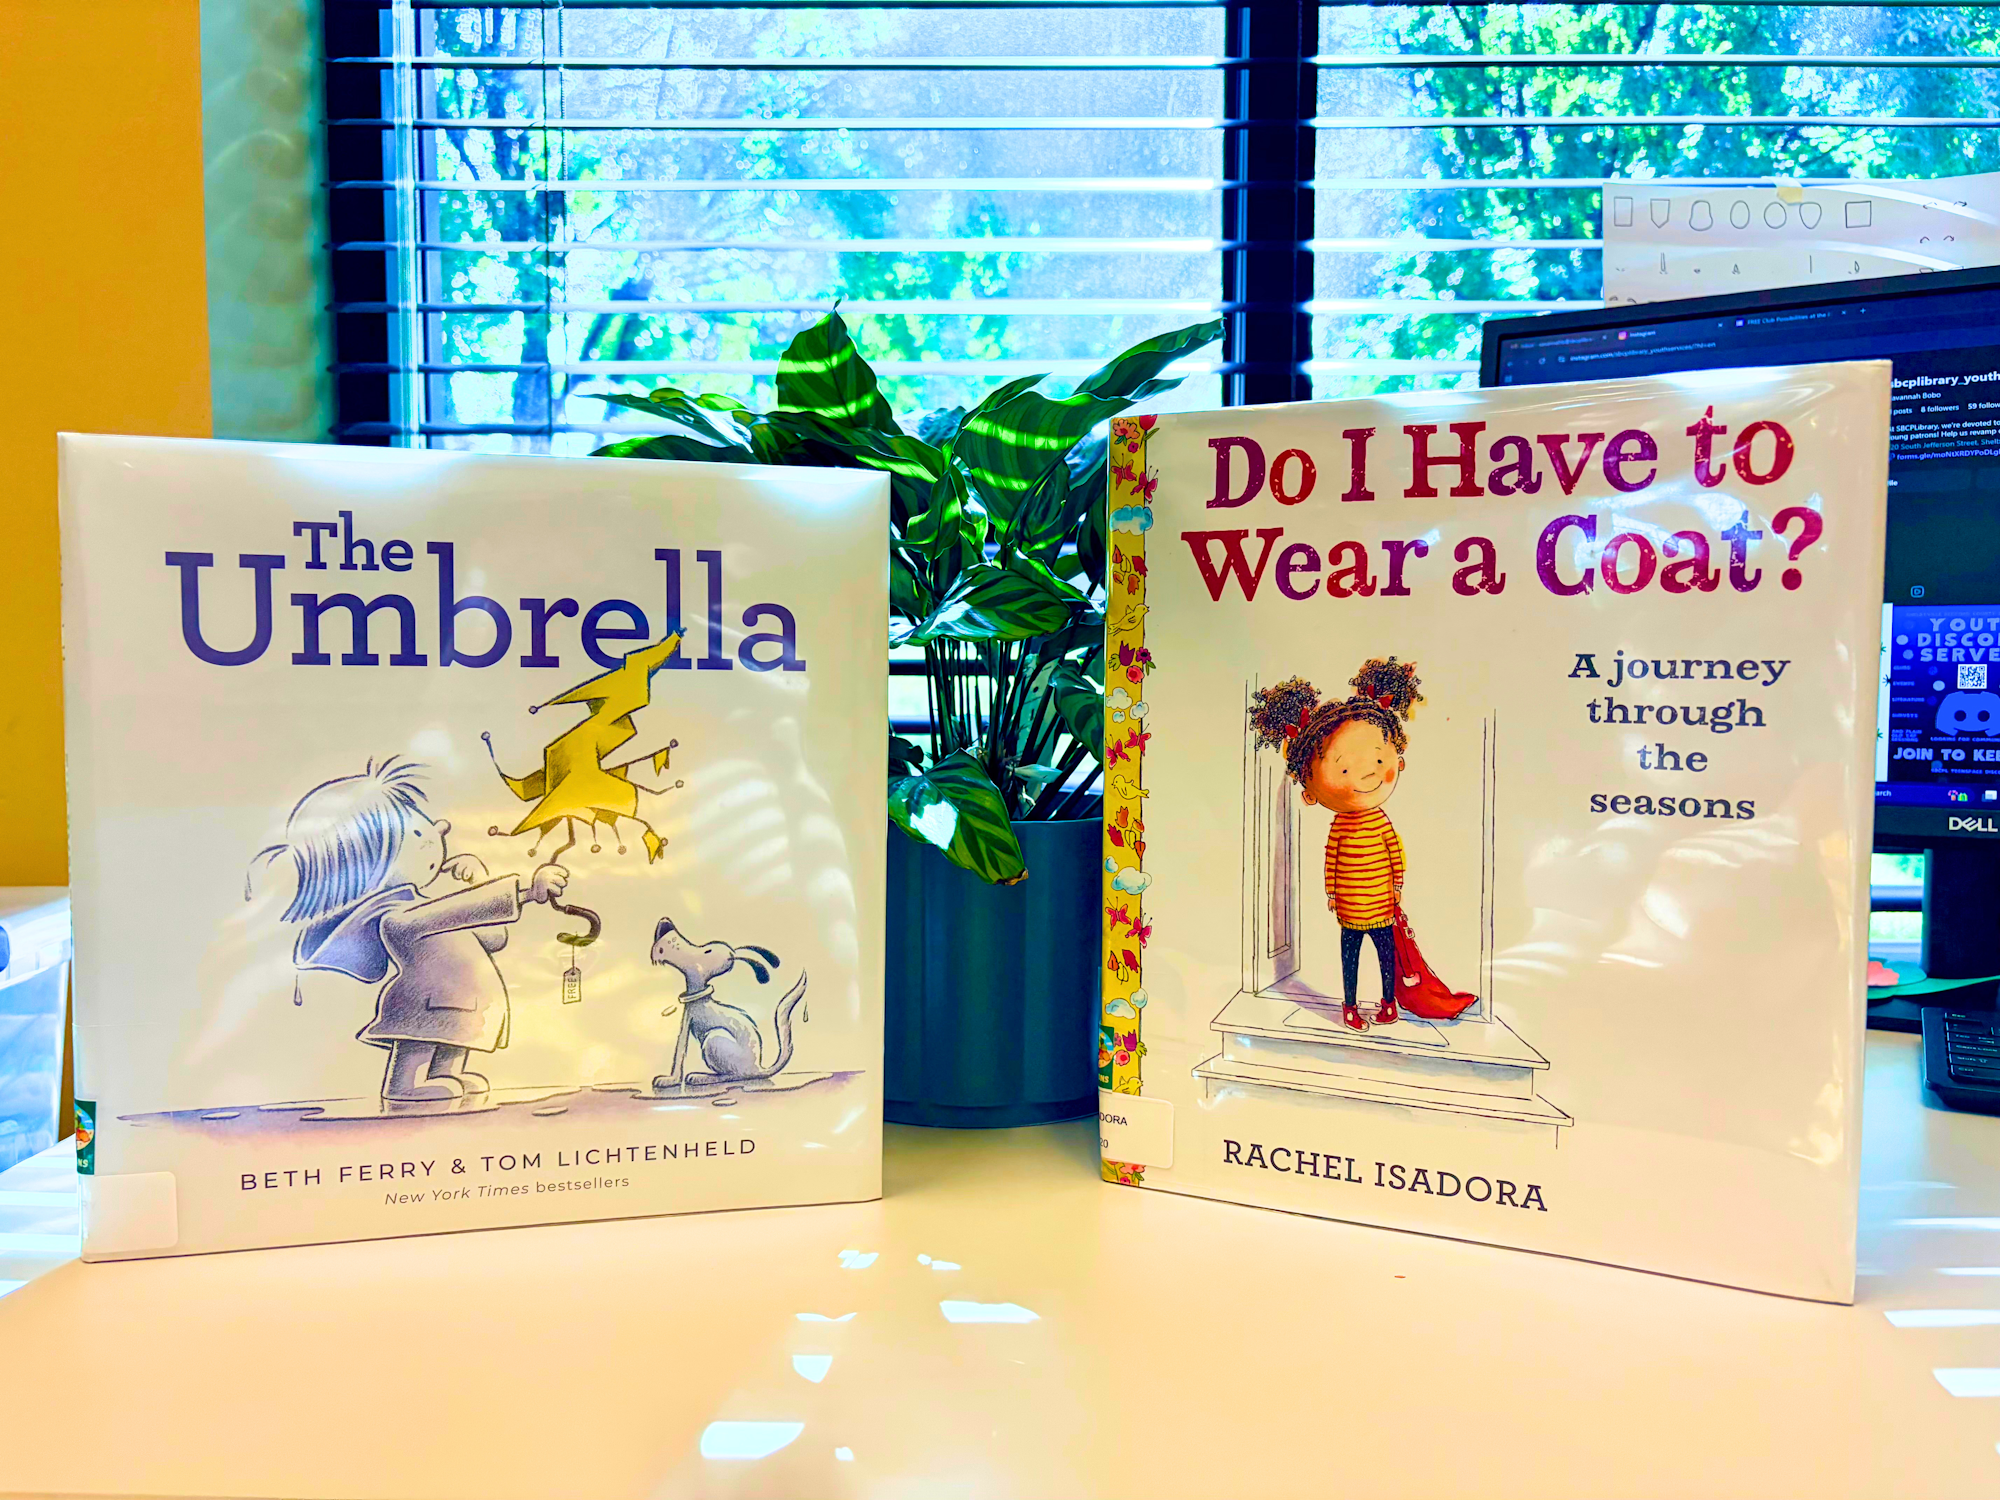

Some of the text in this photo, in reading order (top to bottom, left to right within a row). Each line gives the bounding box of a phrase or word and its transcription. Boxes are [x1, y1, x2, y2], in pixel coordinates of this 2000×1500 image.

[1922, 391, 1941, 400] Bobo
[1893, 408, 1913, 416] posts
[1927, 405, 1959, 413] followers
[1890, 433, 1908, 441] oung
[1910, 431, 1940, 440] patrons!
[1941, 430, 1958, 438] Help
[1970, 429, 1997, 437] revamp
[1962, 420, 1992, 428] devoted
[1206, 405, 1794, 509] Do I Have to
[1901, 442, 1922, 450] South
[1923, 441, 1955, 449] Jefferson
[293, 511, 413, 571] The
[1181, 506, 1824, 602] Wear a Coat?
[165, 542, 806, 672] Umbrella
[1929, 617, 2000, 632] YOUT
[1917, 632, 2000, 647] DISCO
[1920, 647, 2000, 662] SERVE
[1567, 649, 1791, 688] A journey
[1586, 696, 1767, 734] through
[1637, 743, 1708, 773] the
[1893, 747, 1933, 760] JOIN
[1941, 748, 1966, 761] TO
[1590, 792, 1756, 820] seasons
[1948, 816, 1998, 832] DELL
[567, 977, 577, 999] FREE
[241, 1139, 756, 1191] BETH FERRY & TOM LICHTENHELD
[1223, 1139, 1548, 1212] RACHEL ISADORA
[384, 1177, 630, 1205] New York Times bestsellers
